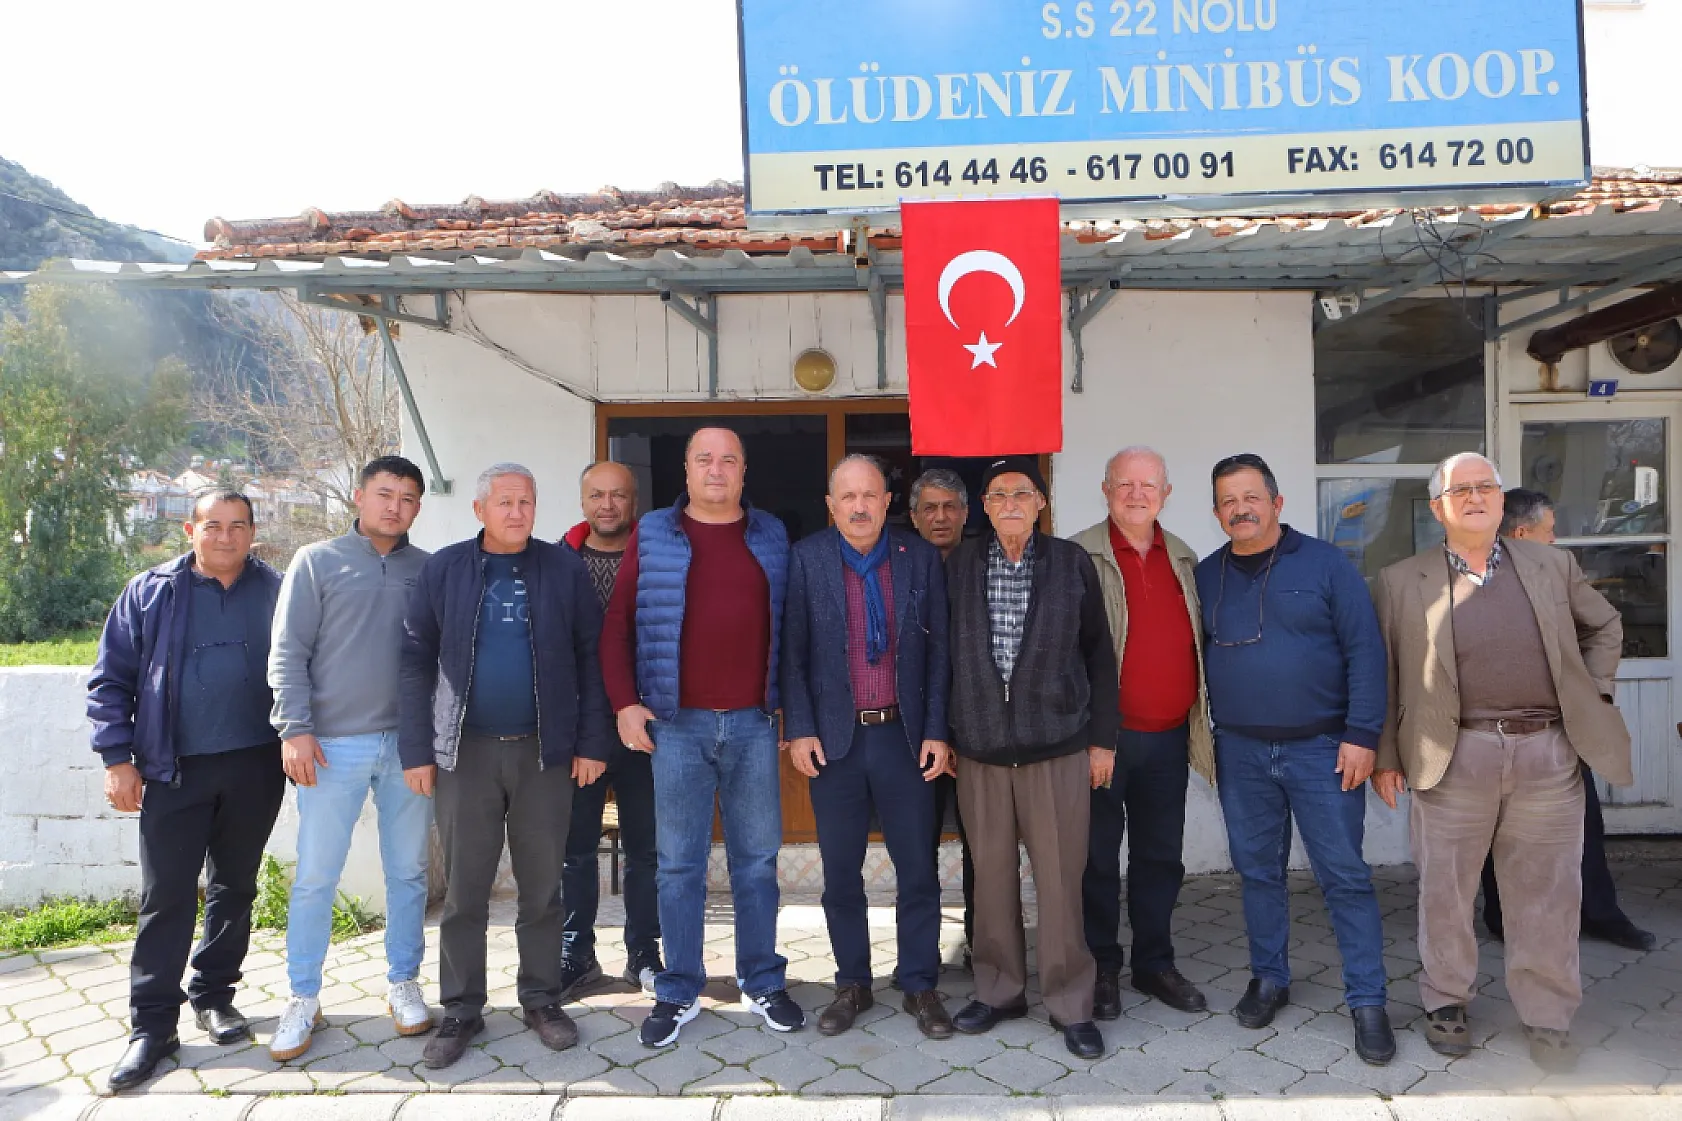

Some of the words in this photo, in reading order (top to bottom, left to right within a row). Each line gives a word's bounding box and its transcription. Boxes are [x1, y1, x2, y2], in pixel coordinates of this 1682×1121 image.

[1041, 2, 1096, 39] S.S
[1109, 0, 1158, 37] 22
[1172, 0, 1277, 34] NOLU
[768, 56, 1076, 127] ÖLÜDENİZ
[1098, 44, 1362, 113] MİNİBÜS
[1386, 48, 1559, 102] KOOP.
[814, 163, 884, 191] TEL:
[895, 159, 952, 188] 614
[961, 157, 1000, 185] 44
[1009, 156, 1048, 184] 46
[1086, 153, 1142, 181] 617
[1153, 152, 1191, 179] 00
[1200, 150, 1235, 178] 91
[1287, 145, 1360, 174] FAX:
[1379, 141, 1438, 169] 614
[1447, 139, 1486, 167] 72
[1496, 137, 1535, 166] 00
[1598, 383, 1607, 395] 4
